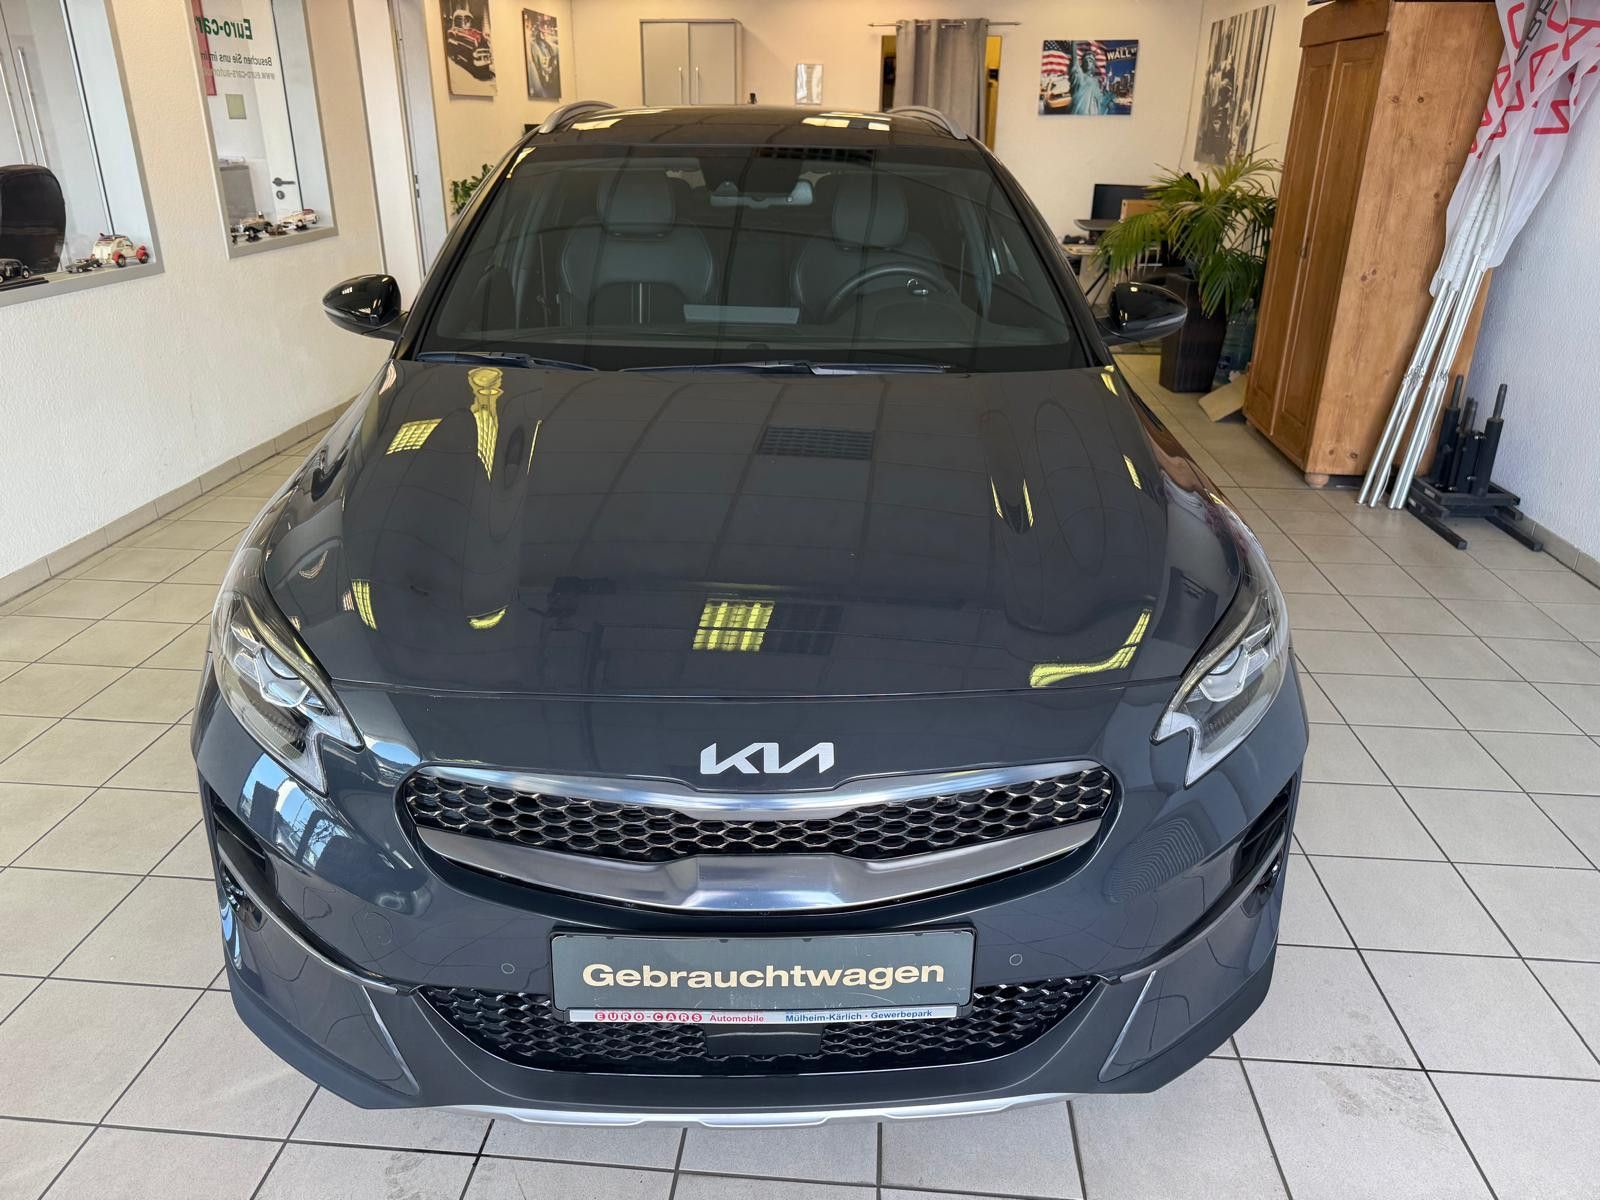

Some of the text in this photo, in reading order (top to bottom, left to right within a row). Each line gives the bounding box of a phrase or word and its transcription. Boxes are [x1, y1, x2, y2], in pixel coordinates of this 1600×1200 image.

[700, 742, 835, 775] KIA
[582, 963, 945, 990] Gebrauchtwagen
[594, 1009, 932, 1023] EURO-CARS Automobile Mülheim-Kärlich Gewerbepark
